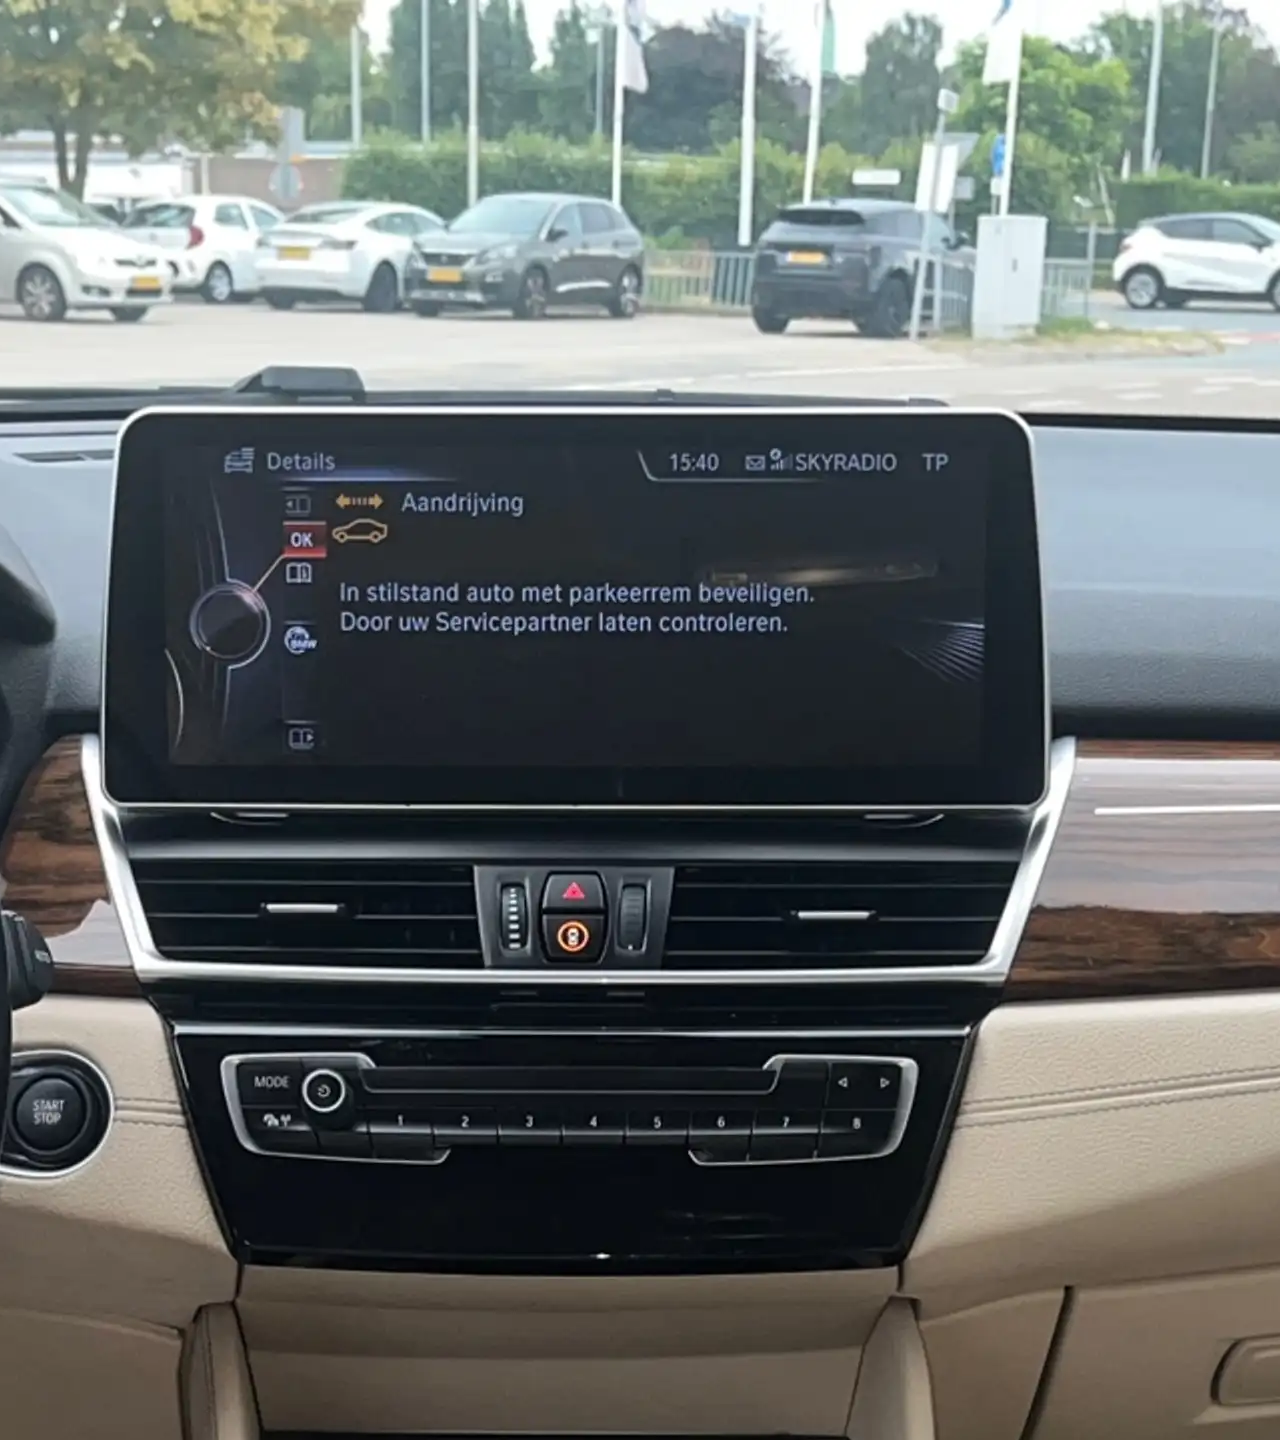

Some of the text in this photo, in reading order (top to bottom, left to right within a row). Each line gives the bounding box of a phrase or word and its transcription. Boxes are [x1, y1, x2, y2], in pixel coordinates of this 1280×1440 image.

[267, 452, 335, 471] Details
[670, 453, 719, 472] 15:40
[795, 453, 897, 472] SKYRADIO
[923, 453, 949, 471] TP
[402, 493, 524, 516] Aandrijving
[291, 533, 313, 547] OK
[340, 583, 815, 608] In stilstand auto met parkeerrem beveiligen.
[340, 612, 788, 636] Door uw Servicepartner laten controleren.
[254, 1076, 290, 1088] MODE
[33, 1100, 65, 1112] START
[33, 1112, 62, 1125] STOP
[397, 1116, 404, 1127] 1
[461, 1116, 469, 1127] 2
[525, 1116, 534, 1128] 3
[589, 1116, 598, 1127] 4
[653, 1117, 662, 1128] 5
[717, 1117, 725, 1128] 6
[782, 1117, 790, 1128] 7
[853, 1118, 861, 1129] 8
